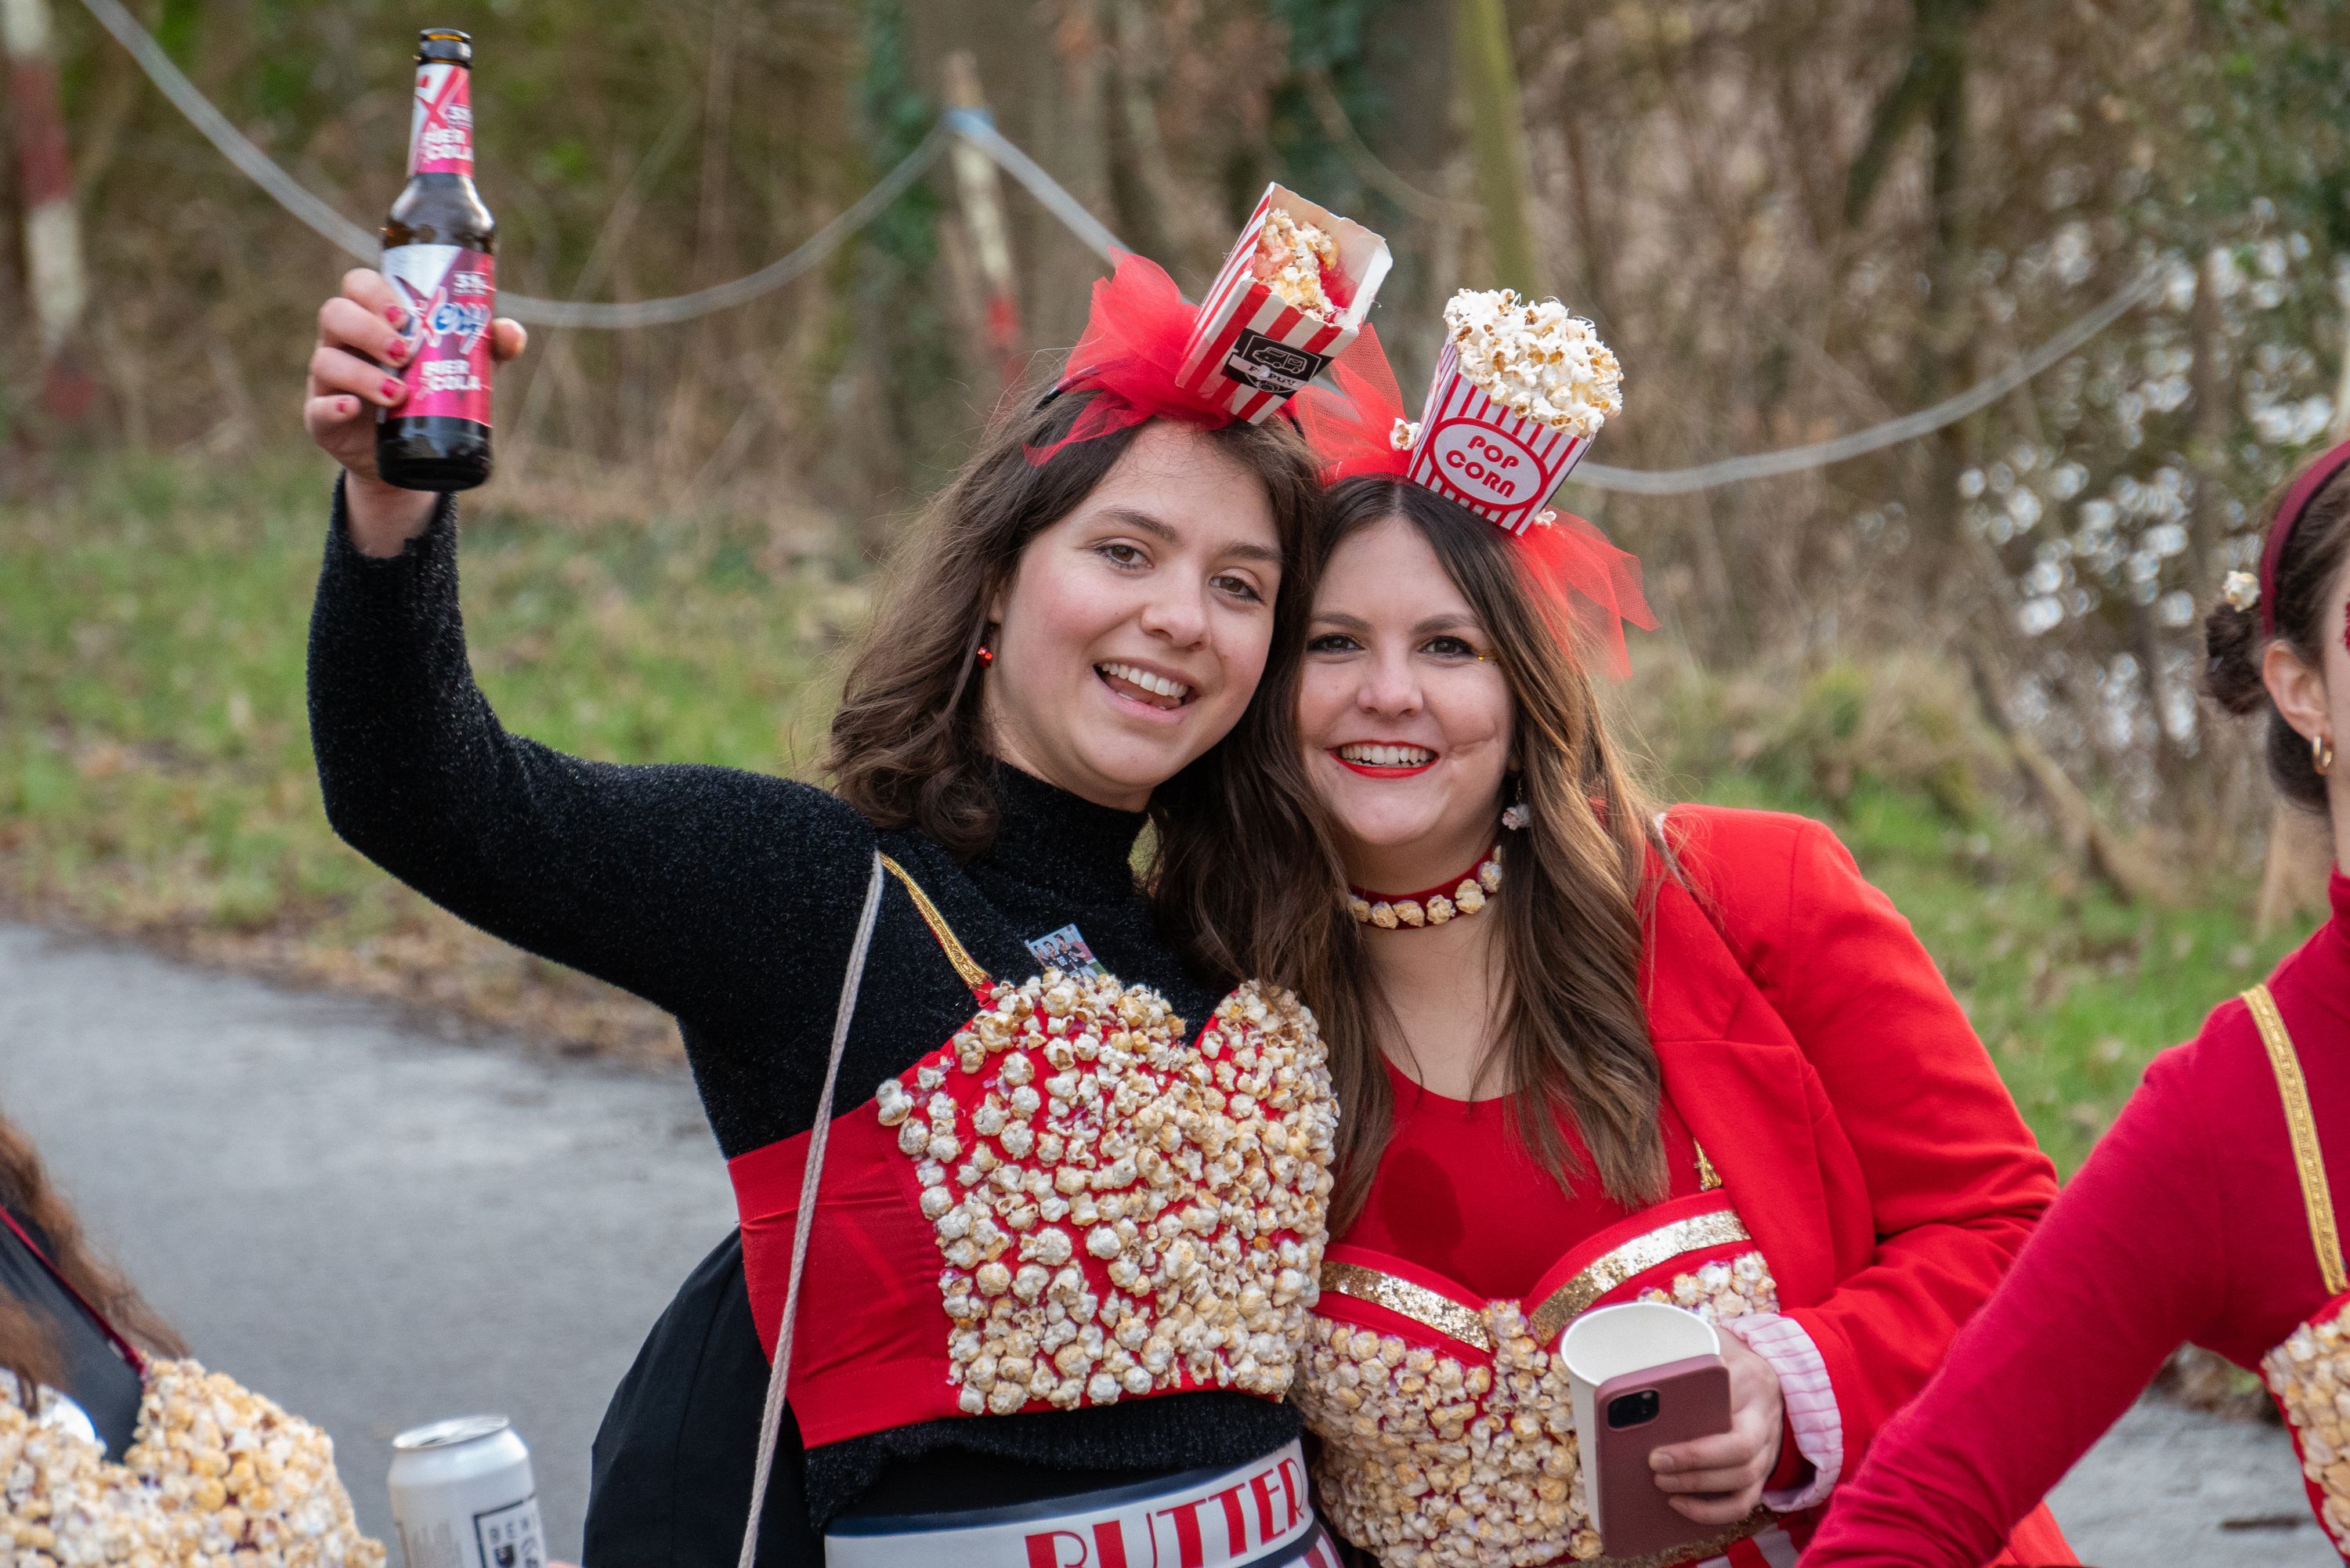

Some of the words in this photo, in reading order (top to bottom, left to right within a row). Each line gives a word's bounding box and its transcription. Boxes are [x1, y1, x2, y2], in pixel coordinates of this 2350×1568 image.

[421, 359, 471, 377] BIER
[428, 375, 482, 392] COLA
[1467, 435, 1520, 470] POP
[1446, 450, 1517, 498] CORN
